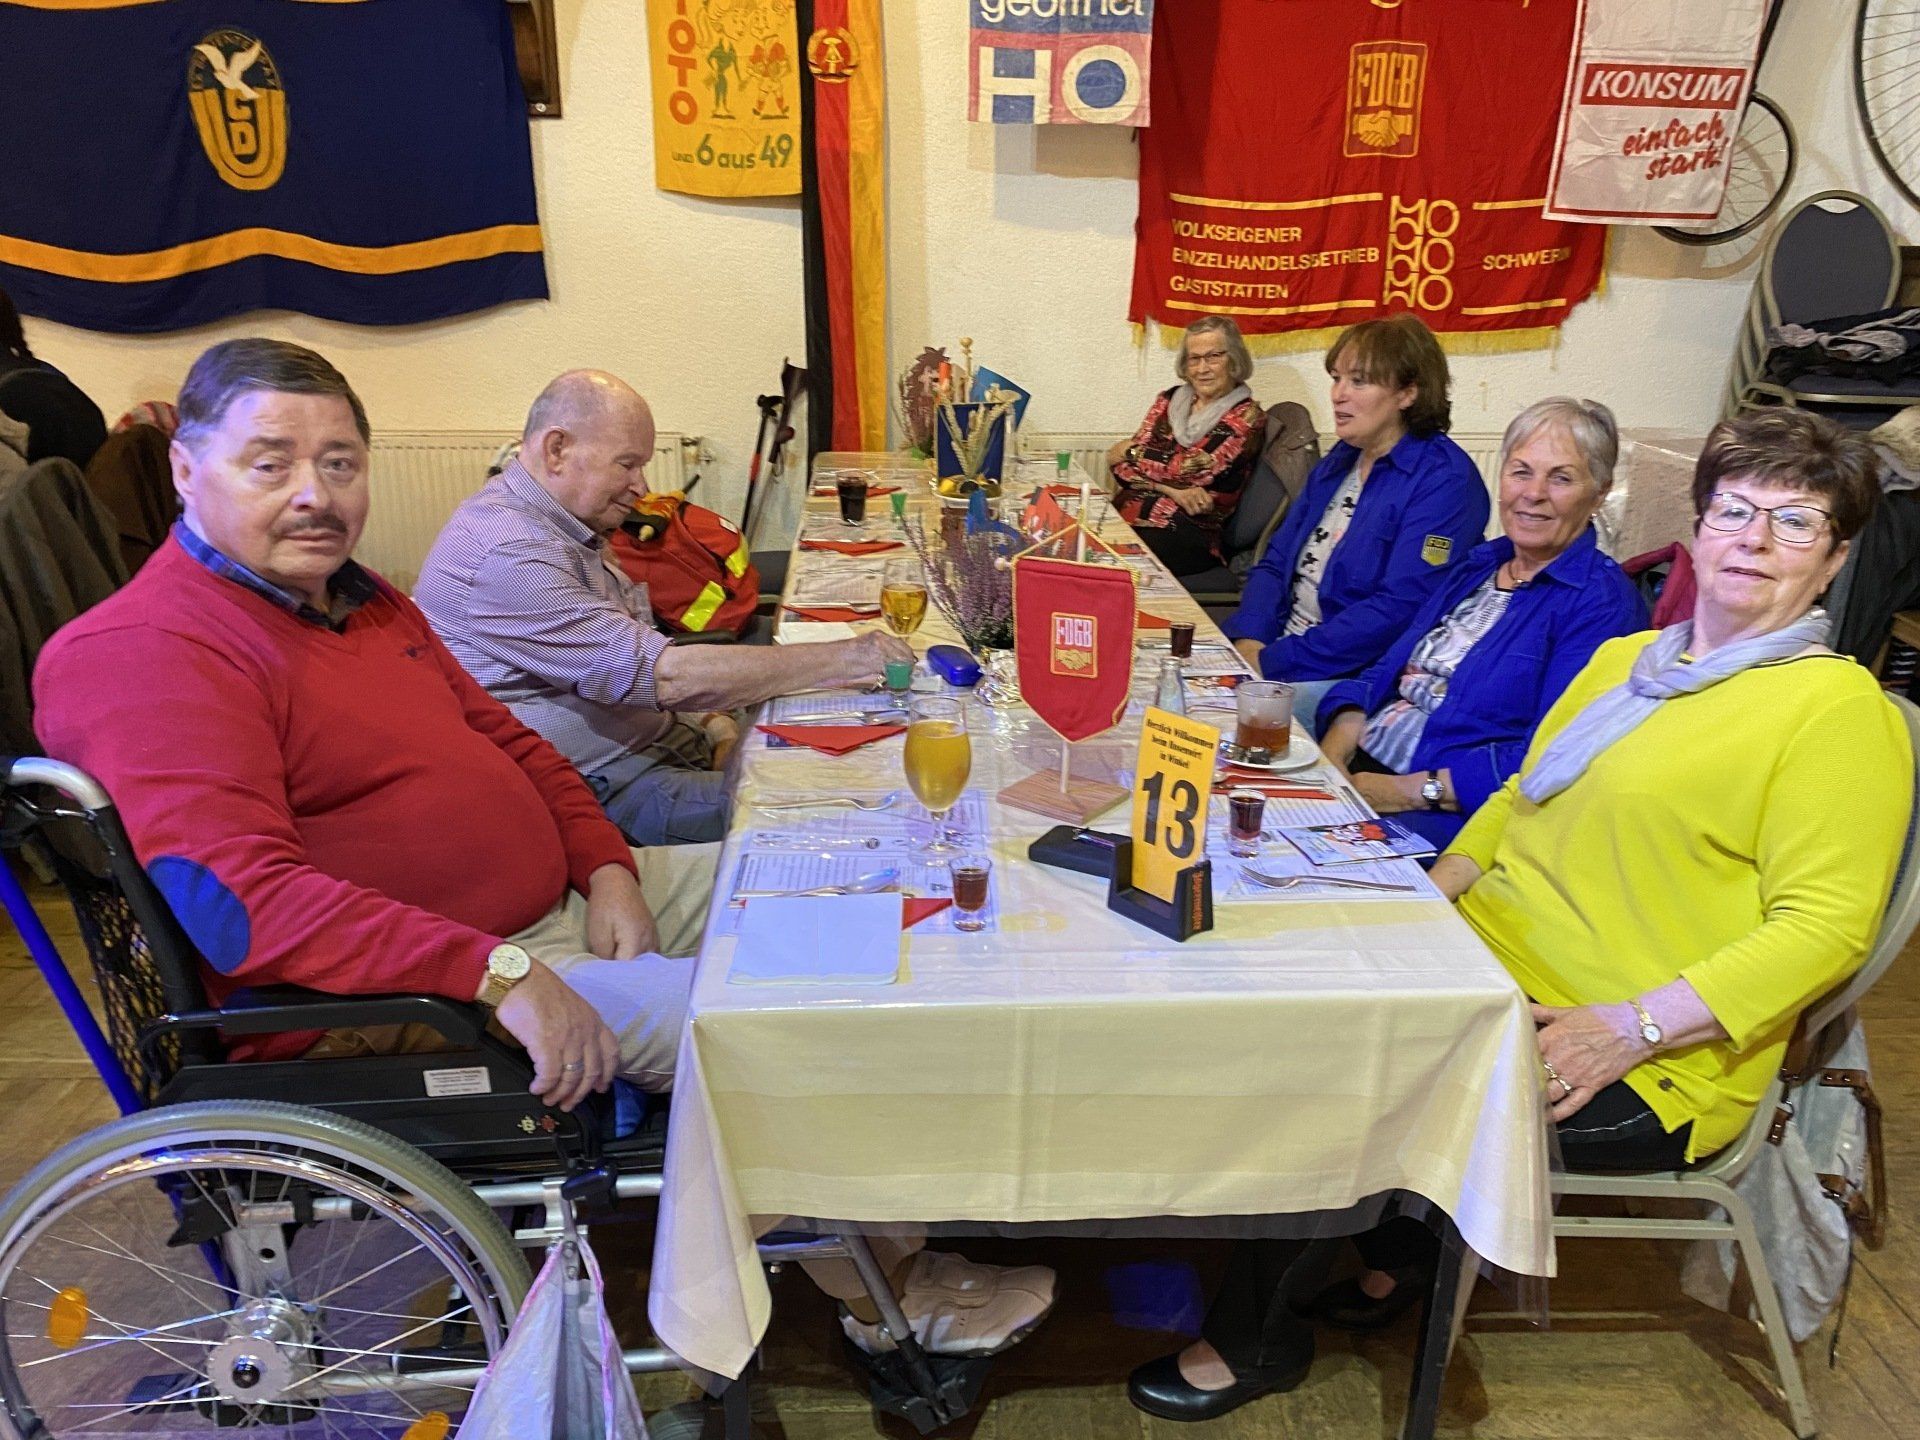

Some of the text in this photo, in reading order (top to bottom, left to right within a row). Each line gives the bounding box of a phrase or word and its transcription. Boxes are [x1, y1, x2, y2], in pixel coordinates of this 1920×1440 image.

[978, 44, 1141, 124] HO
[1353, 52, 1418, 108] FDGB
[1586, 70, 1741, 101] KONSUM
[696, 133, 714, 166] 6
[717, 152, 756, 169] aus
[760, 133, 793, 168] 49
[1622, 110, 1726, 156] einfach
[1645, 136, 1730, 180] stark!
[1172, 218, 1302, 244] VOLKSEIGENER
[1055, 617, 1093, 648] FDGB
[1174, 727, 1214, 749] Willkommen
[1142, 770, 1199, 859] 13
